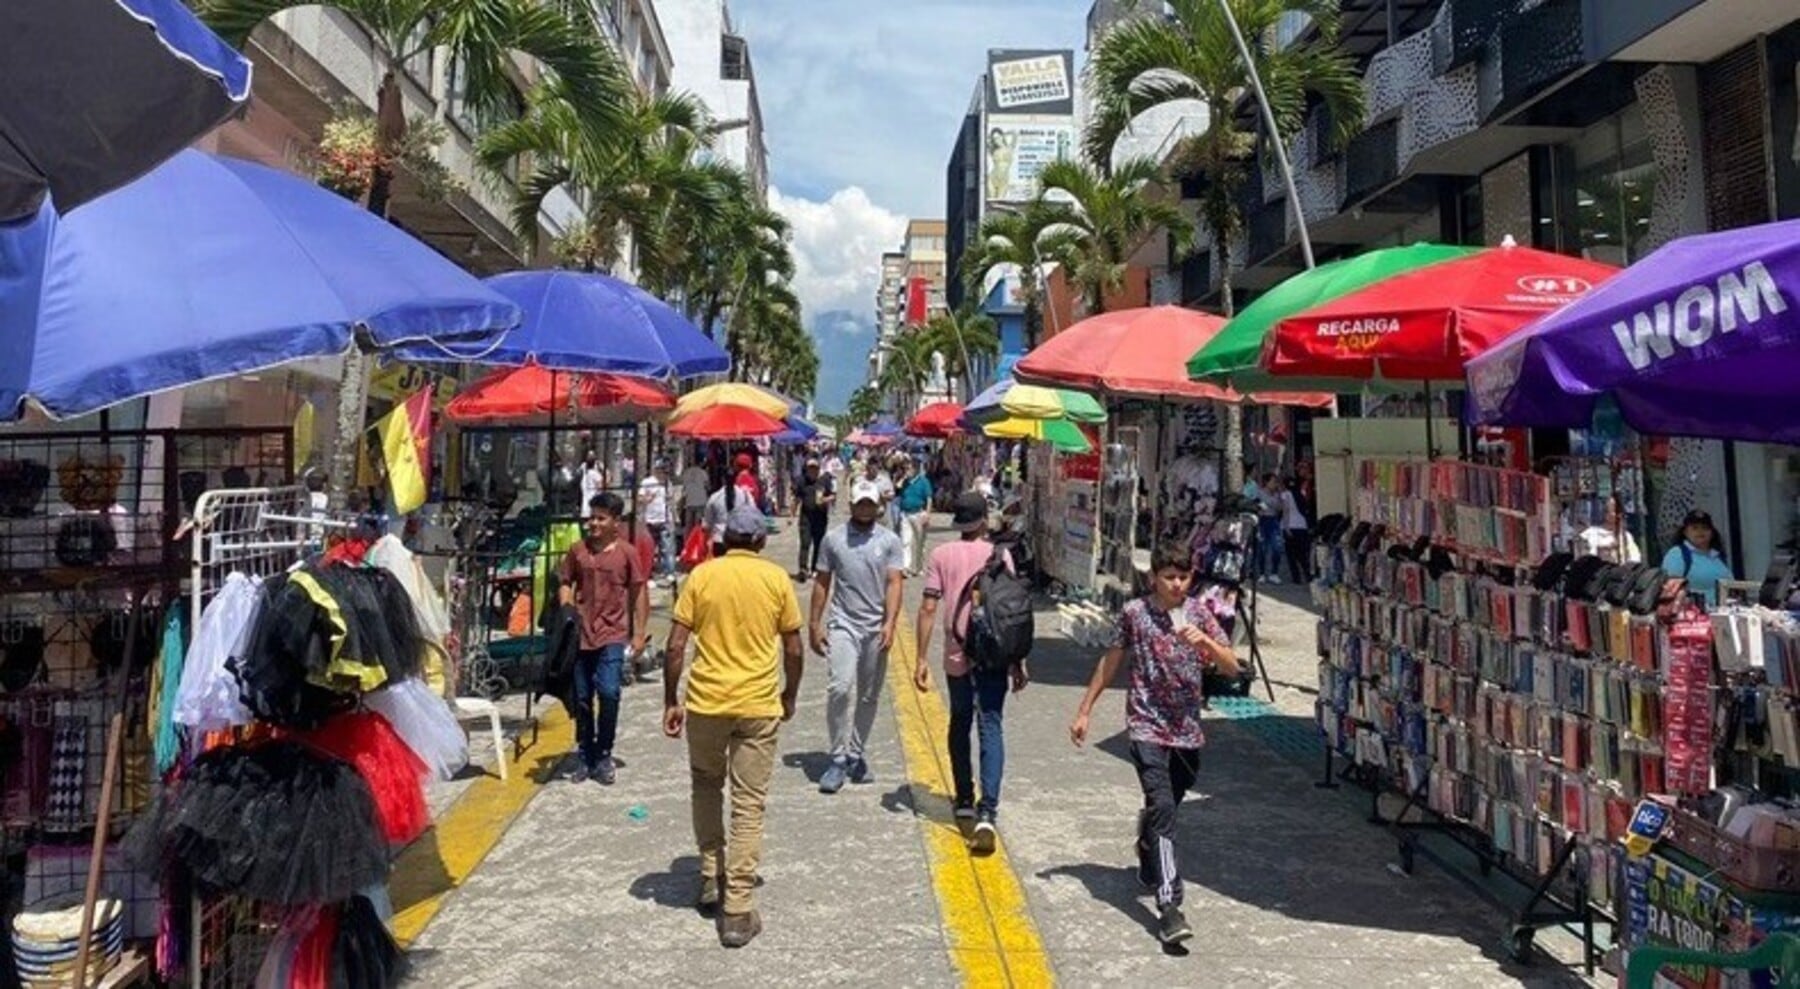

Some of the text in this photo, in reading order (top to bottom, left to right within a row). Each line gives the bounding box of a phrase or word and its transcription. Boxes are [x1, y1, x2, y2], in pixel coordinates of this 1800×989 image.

[998, 59, 1061, 76] VALLA
[1001, 81, 1064, 95] DISPONIBLE
[1532, 279, 1577, 293] #1
[1611, 260, 1788, 371] WOM
[1316, 317, 1400, 336] RECARGA
